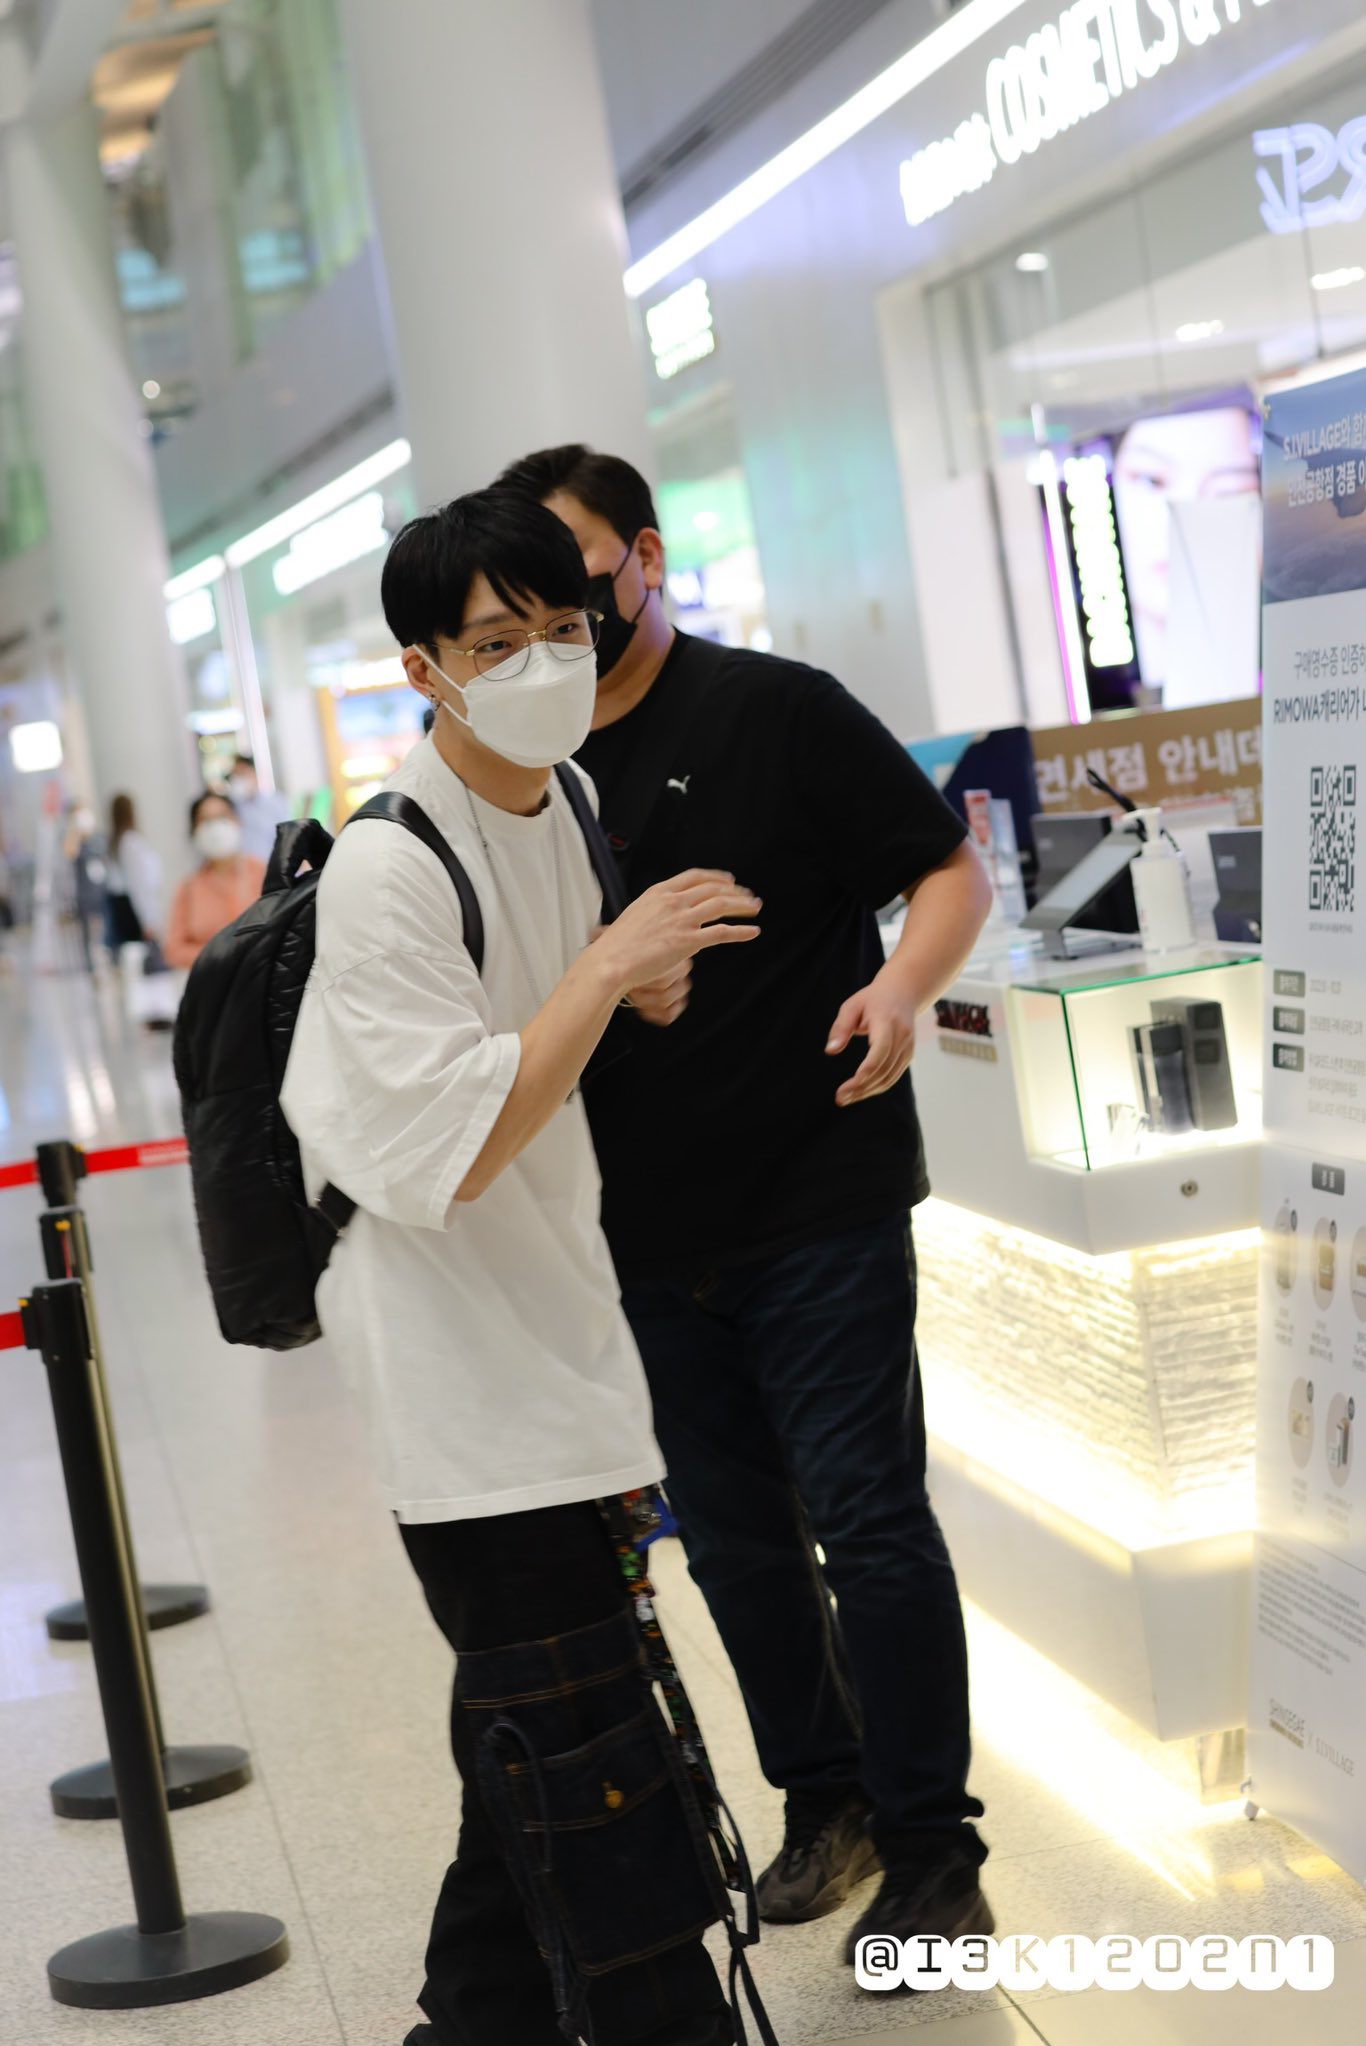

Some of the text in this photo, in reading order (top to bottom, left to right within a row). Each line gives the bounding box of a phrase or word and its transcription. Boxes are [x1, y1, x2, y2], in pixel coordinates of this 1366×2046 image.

[987, 0, 1178, 163] COSMETICS
[1337, 459, 1356, 497] 경품
[1293, 646, 1339, 680] 구매영수증
